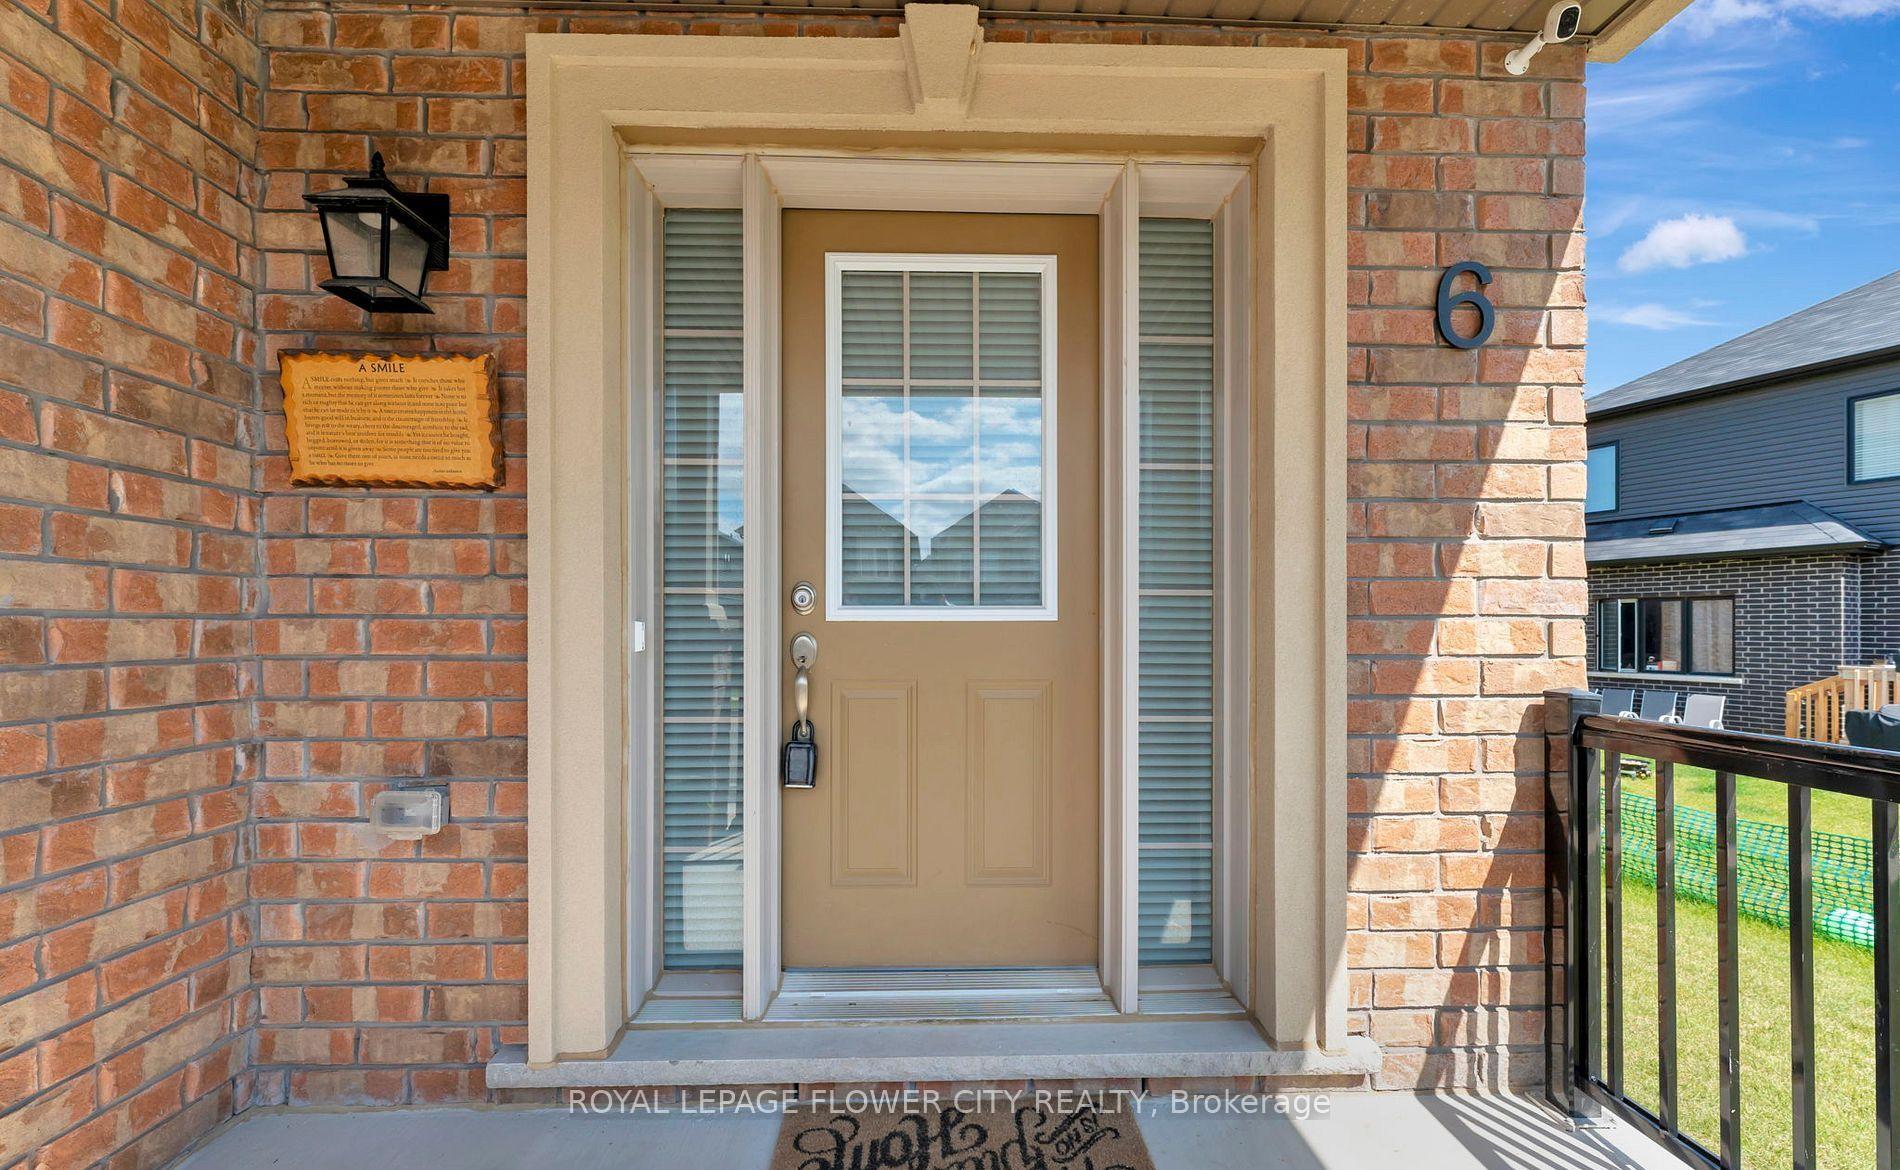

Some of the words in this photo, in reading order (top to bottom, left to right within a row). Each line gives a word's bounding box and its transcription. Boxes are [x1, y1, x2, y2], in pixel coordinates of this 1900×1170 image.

[1436, 261, 1495, 348] 6
[358, 364, 366, 372] A
[371, 363, 405, 372] SMILE
